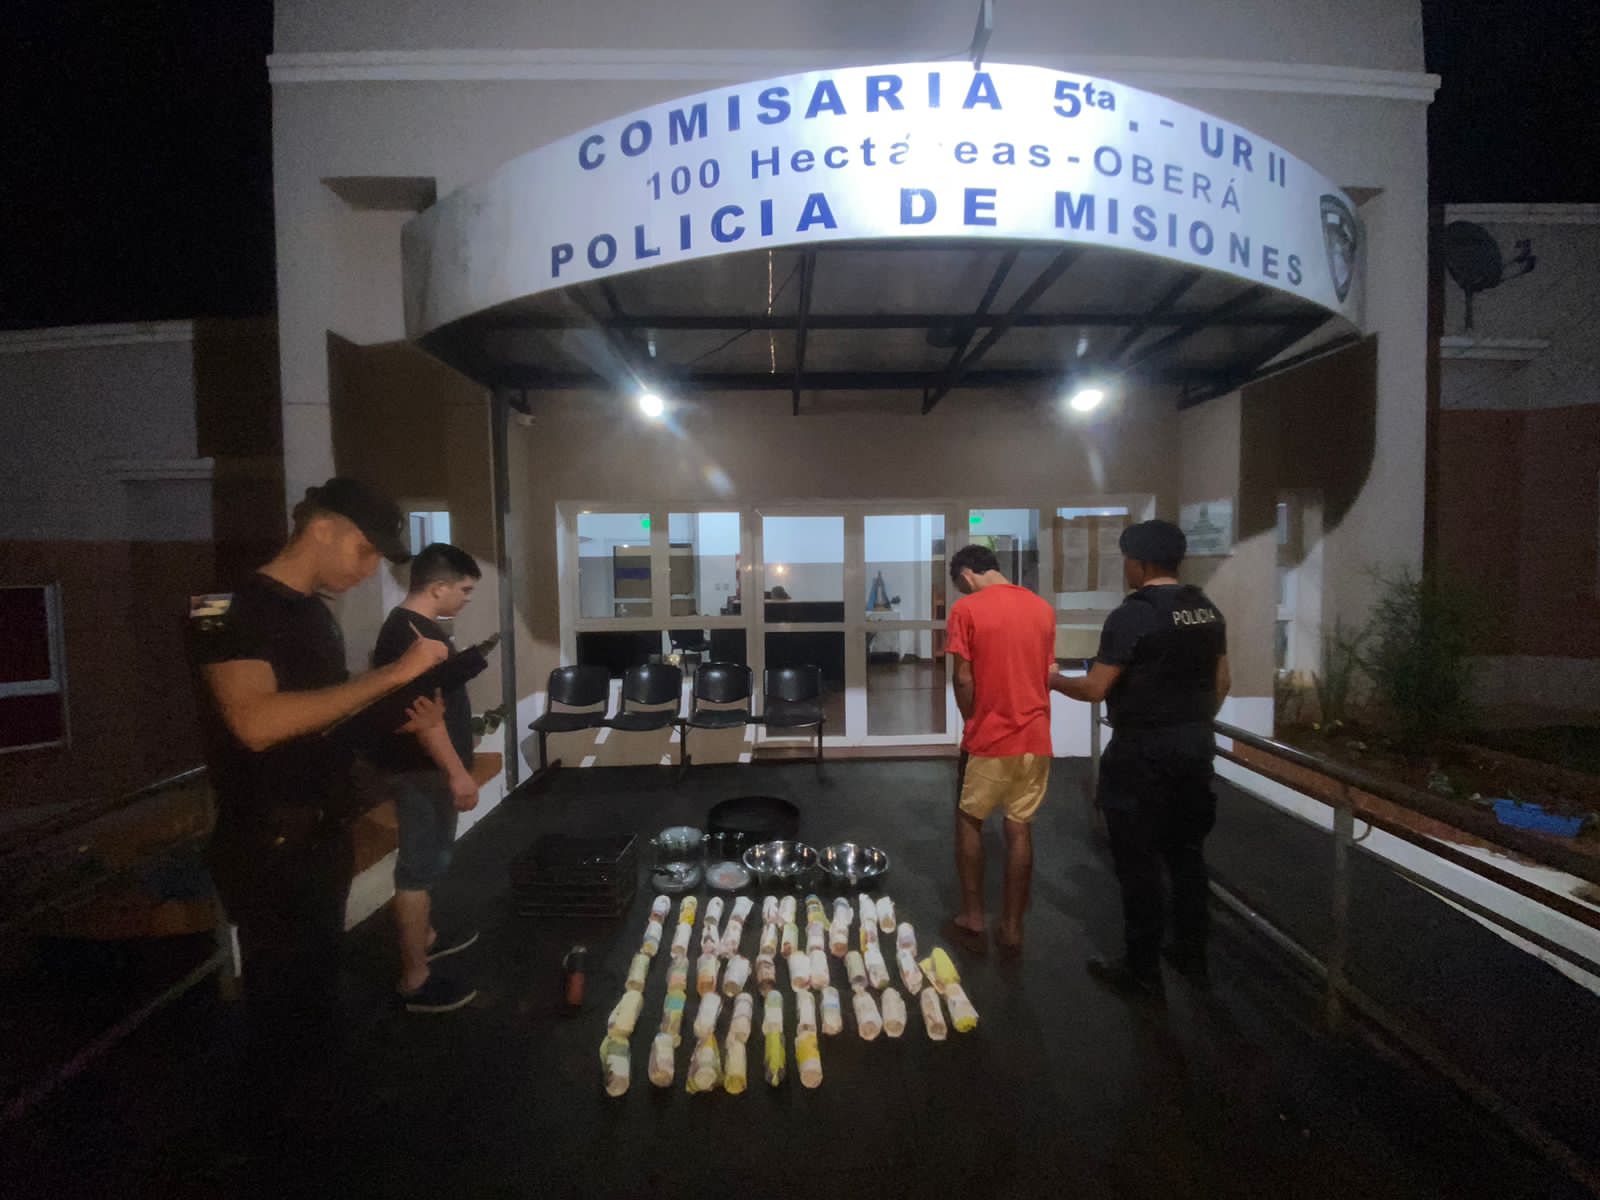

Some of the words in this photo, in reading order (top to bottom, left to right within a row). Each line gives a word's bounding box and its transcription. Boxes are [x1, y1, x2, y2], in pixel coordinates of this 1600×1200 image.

[578, 71, 1003, 170] COMISARIA
[647, 158, 721, 200] 100
[551, 192, 837, 278] POLICIA
[900, 187, 997, 227] DE
[1054, 190, 1302, 286] MISIONES
